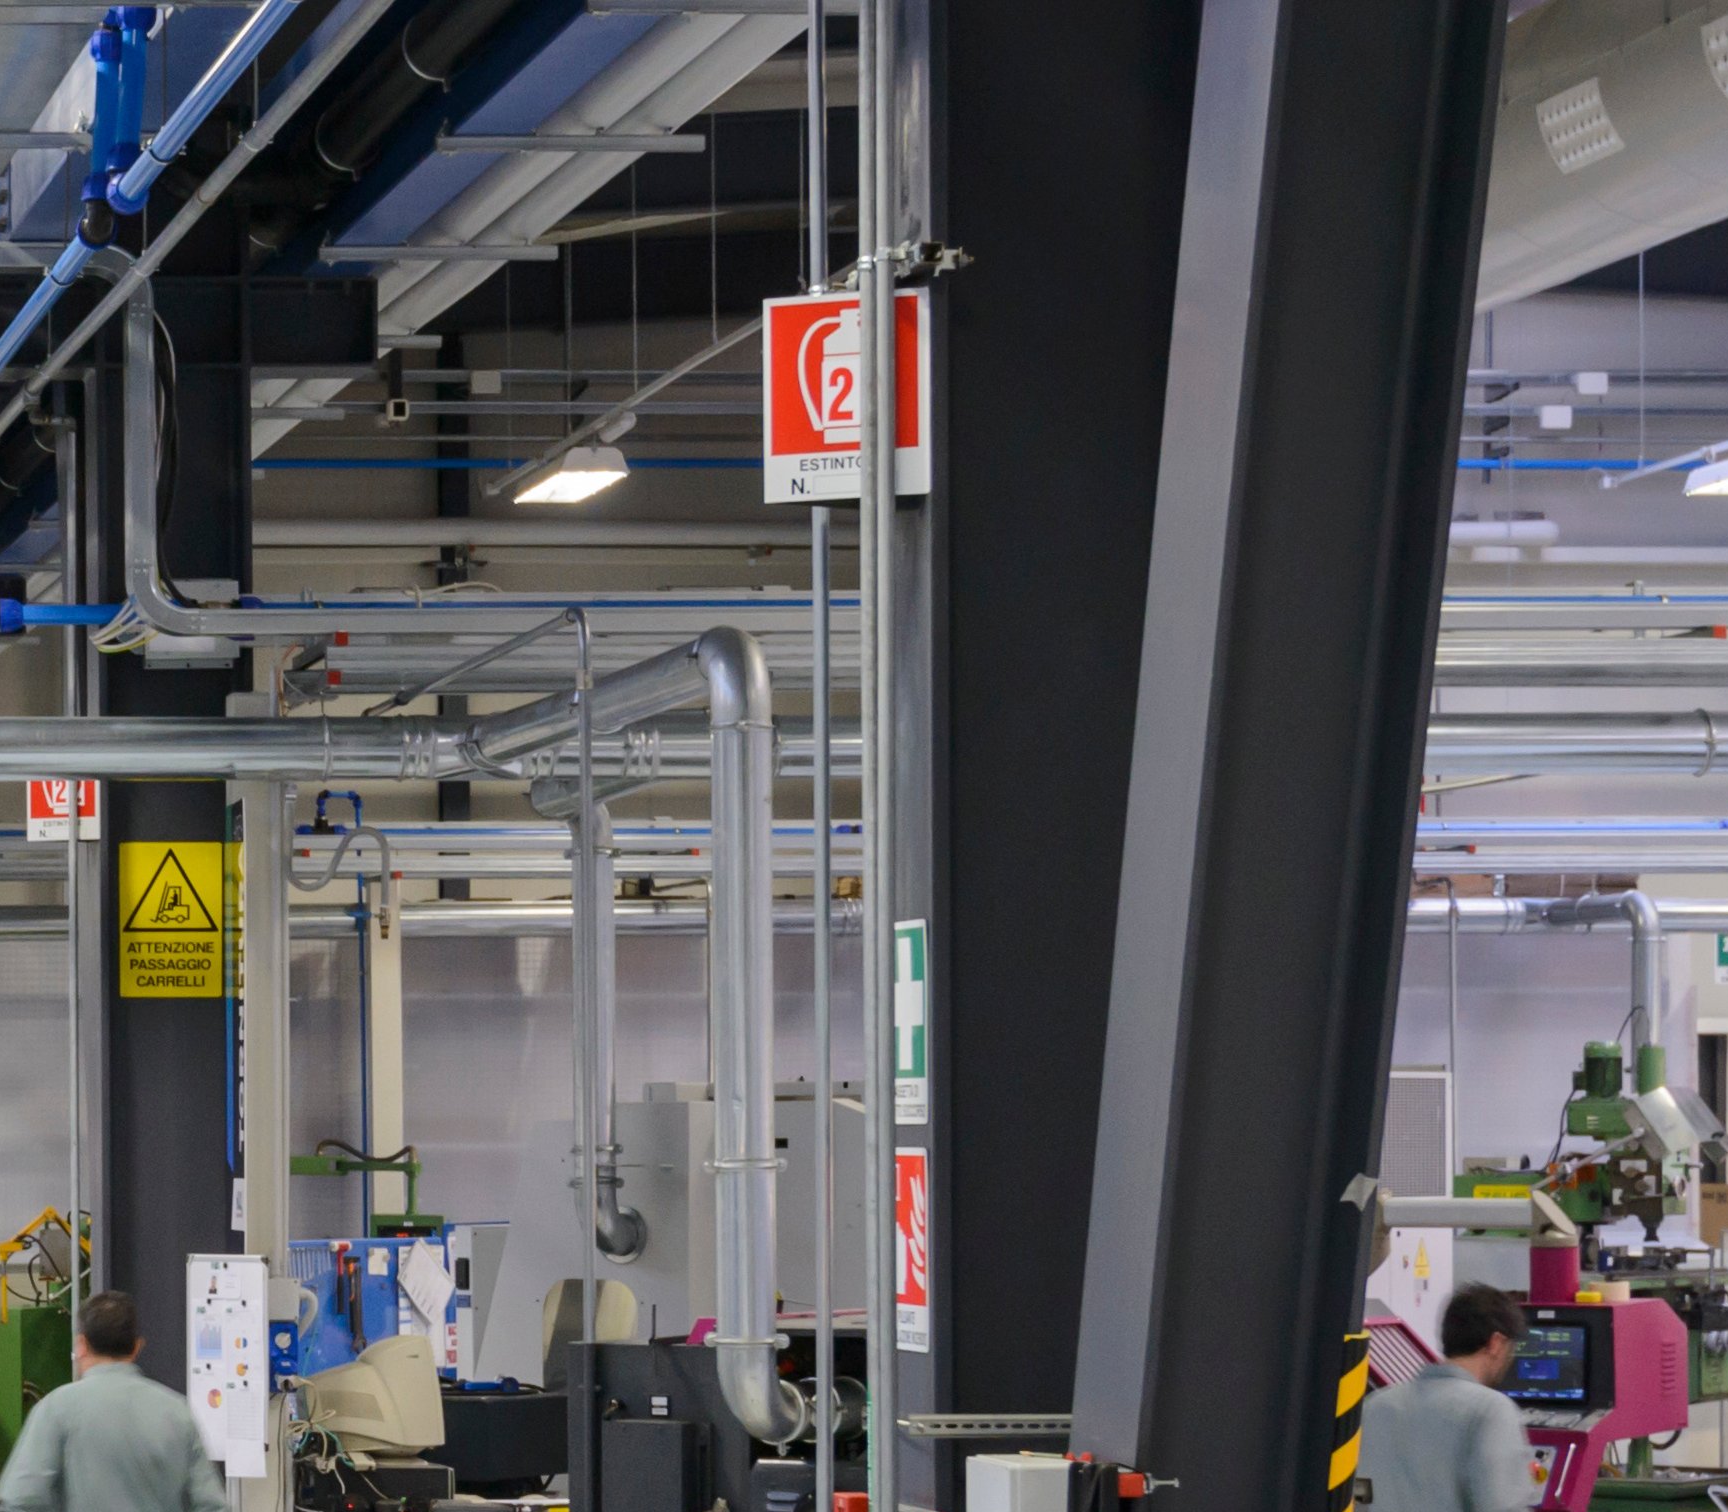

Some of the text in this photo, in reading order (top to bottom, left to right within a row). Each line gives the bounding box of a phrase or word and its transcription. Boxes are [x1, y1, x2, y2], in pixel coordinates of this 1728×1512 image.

[791, 478, 811, 495] N.
[127, 941, 215, 953] ATTENZIONE
[130, 958, 212, 971] PASSAGGIO
[136, 975, 206, 988] CARRELLI
